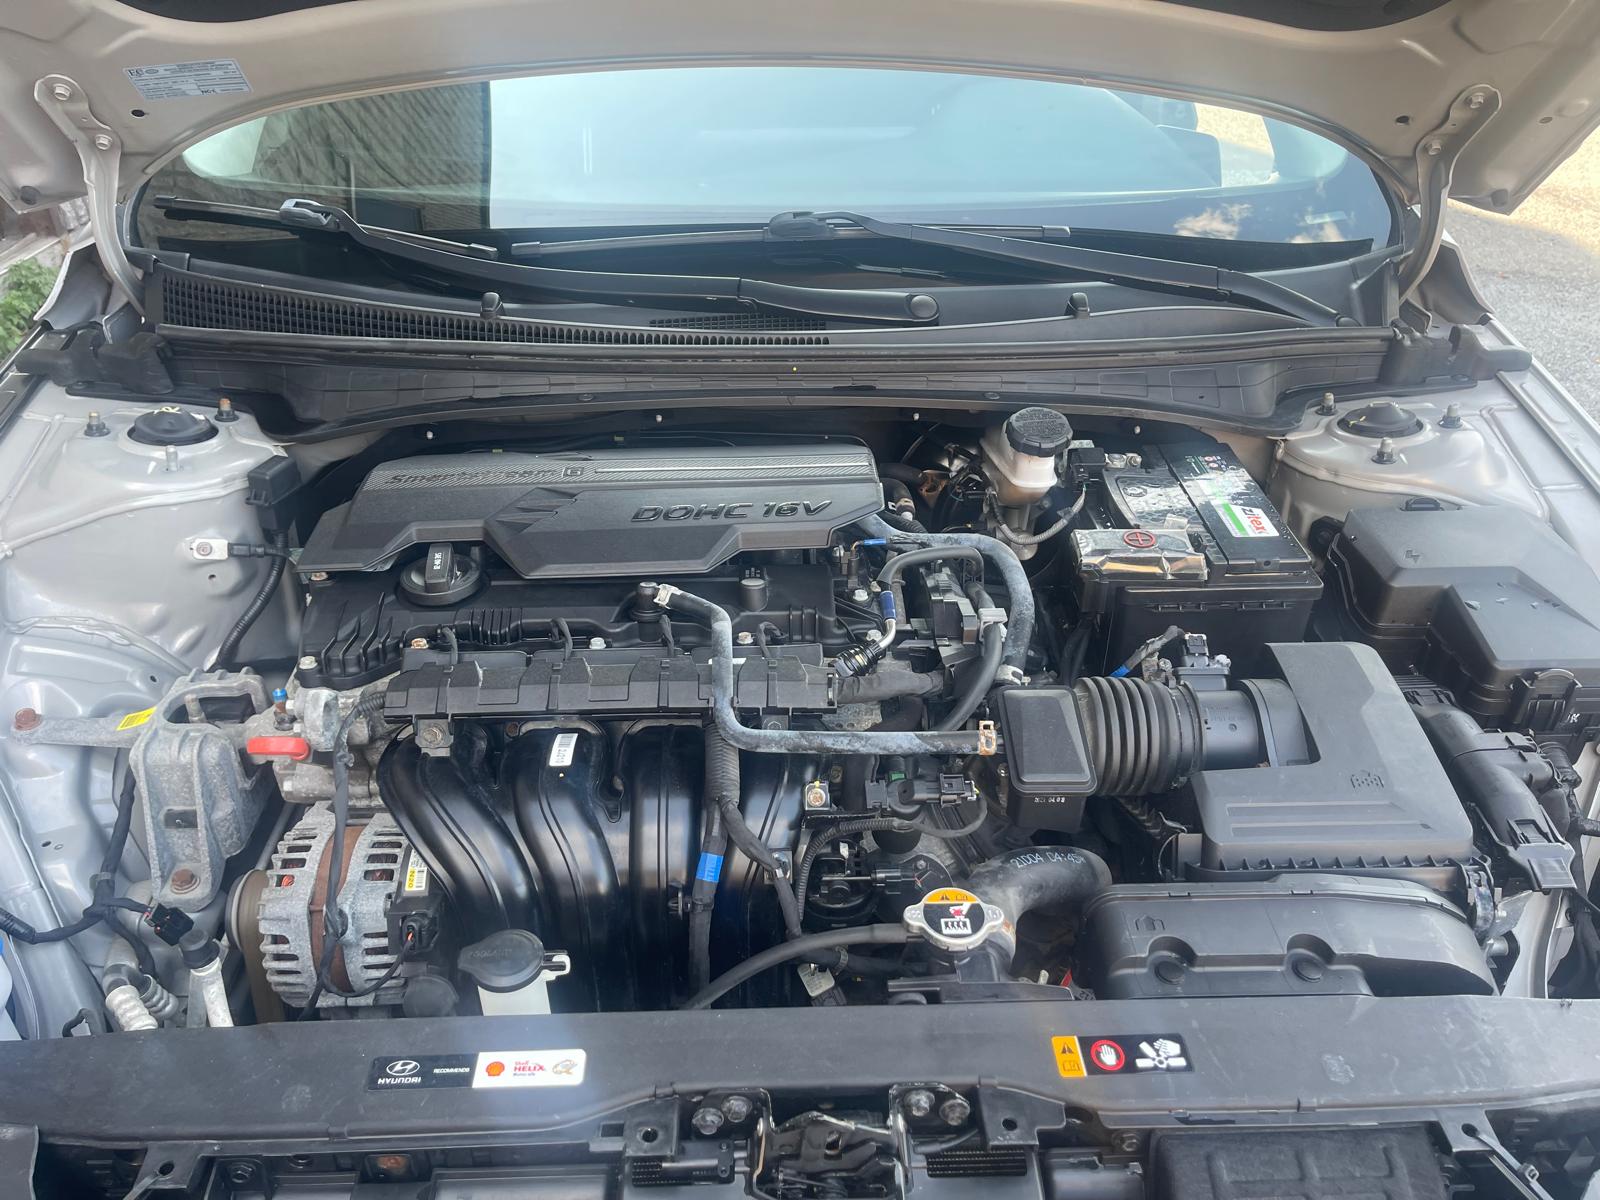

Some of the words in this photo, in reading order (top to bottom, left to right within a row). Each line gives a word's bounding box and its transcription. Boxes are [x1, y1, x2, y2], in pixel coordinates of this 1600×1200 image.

[631, 503, 753, 522] DOHC
[762, 500, 832, 518] 16V
[378, 1076, 421, 1085] HYUNDAI
